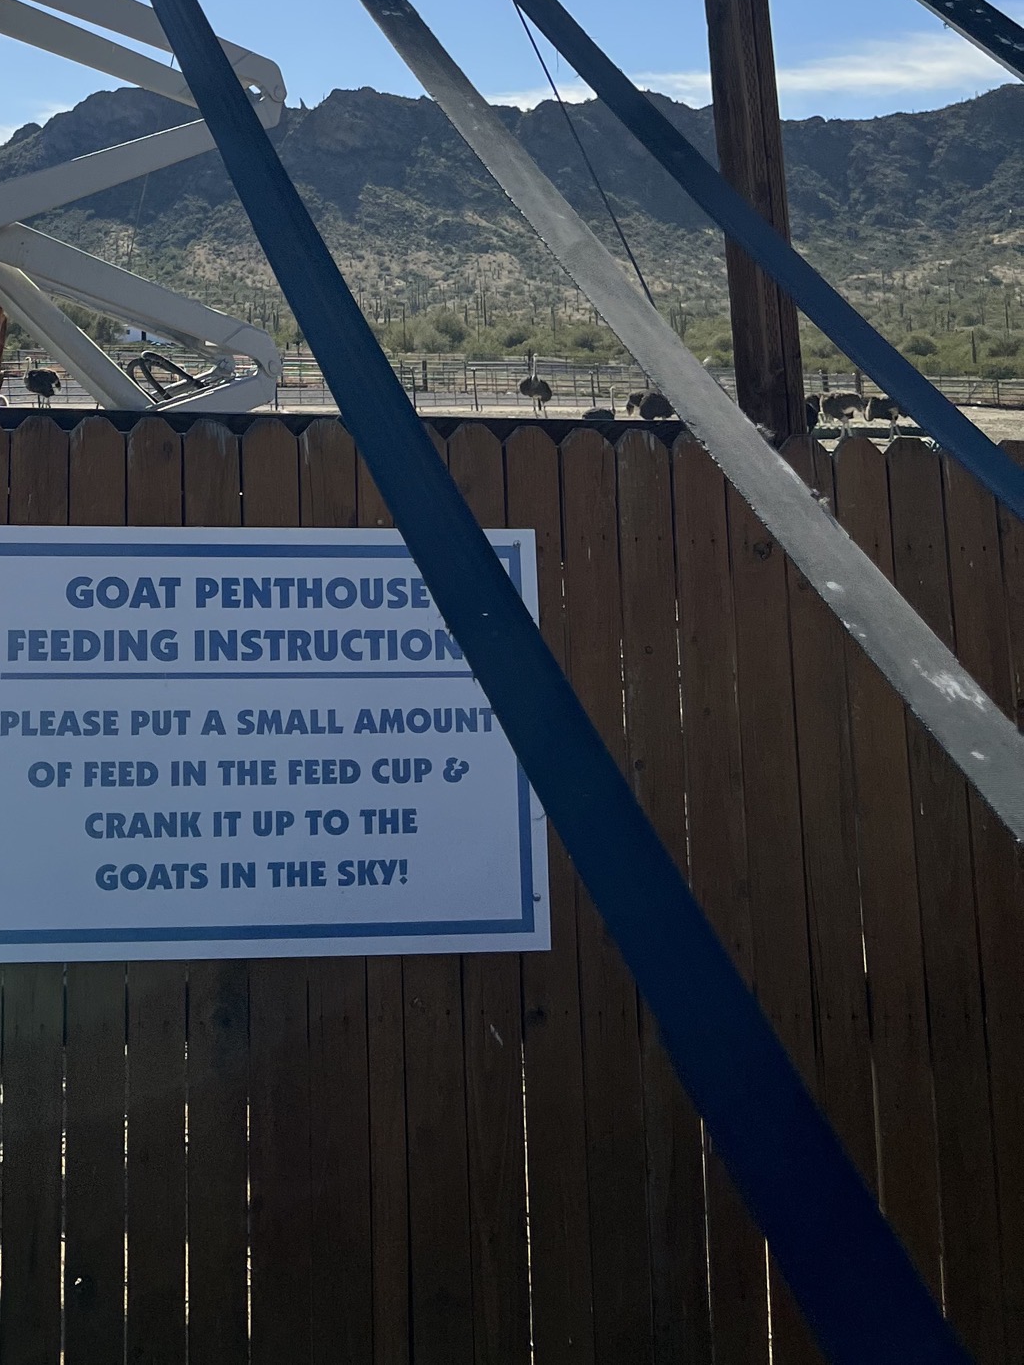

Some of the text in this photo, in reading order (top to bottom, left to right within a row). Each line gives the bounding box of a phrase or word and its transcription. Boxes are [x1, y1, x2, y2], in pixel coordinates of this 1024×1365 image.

[65, 576, 431, 610] GOAT PENTHOUSE
[7, 628, 464, 662] FEEDING INSTRUCTION
[0, 707, 495, 737] PLEASE PUT A SMALL AMOUNT
[27, 756, 470, 788] OF FEED IN THE FEED CUP &
[84, 808, 418, 840] CRANK IT UP TO THE
[95, 858, 408, 891] GOATS IN THE SKY!
